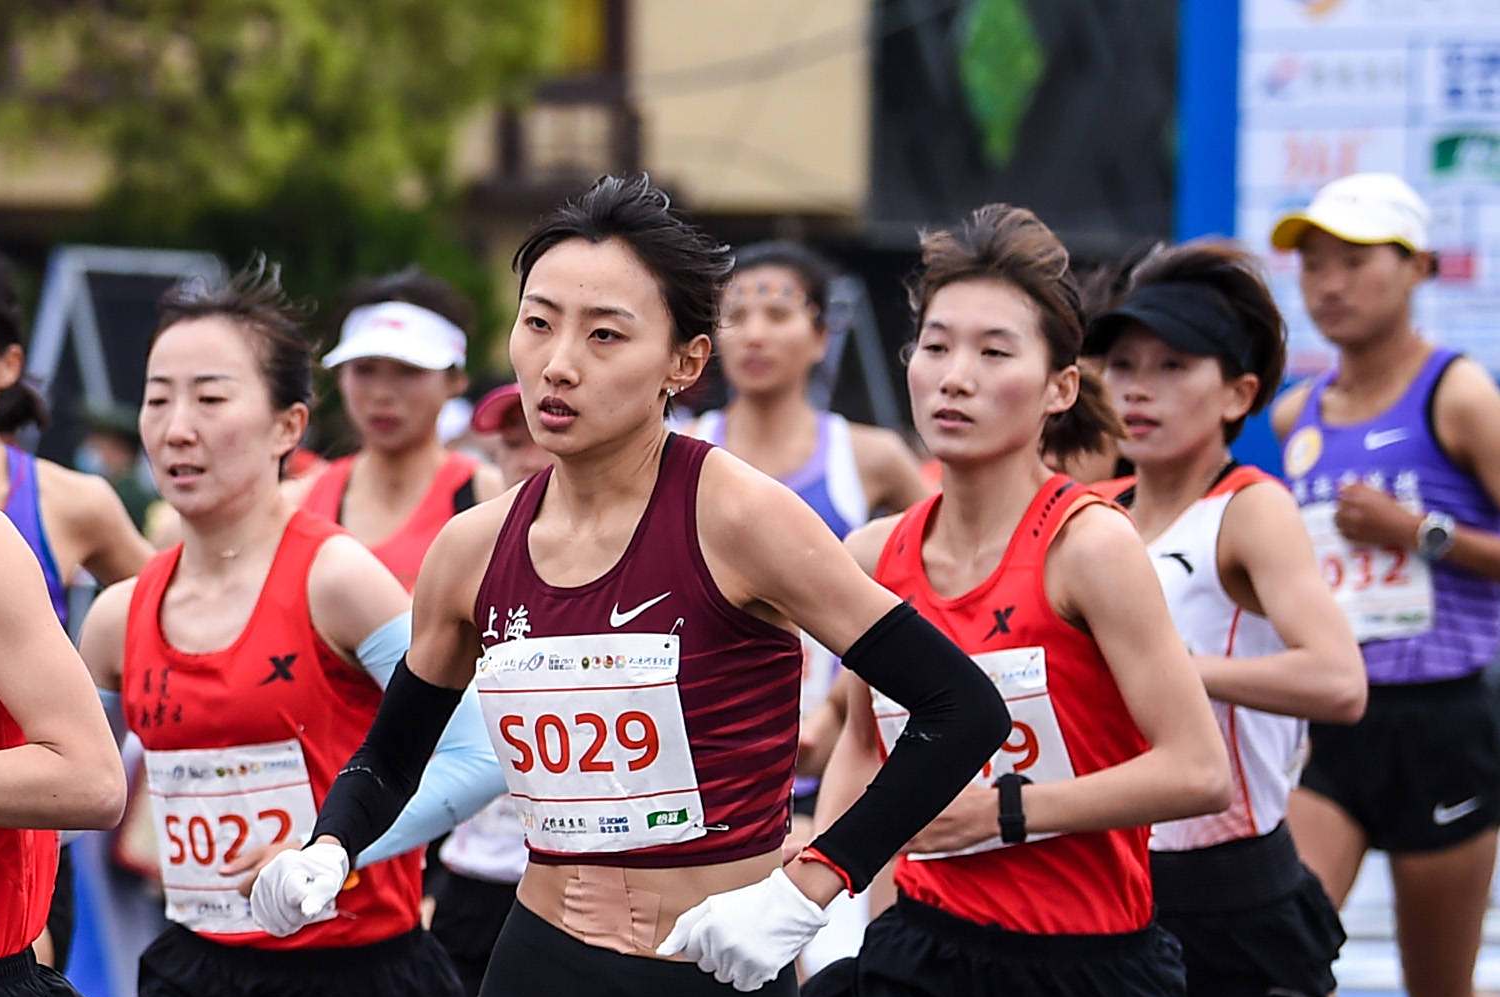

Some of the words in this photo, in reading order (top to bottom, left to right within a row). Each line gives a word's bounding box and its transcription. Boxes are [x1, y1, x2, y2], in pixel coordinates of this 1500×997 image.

[1322, 545, 1410, 592] 032
[482, 605, 531, 640] 上海
[499, 711, 660, 774] S029
